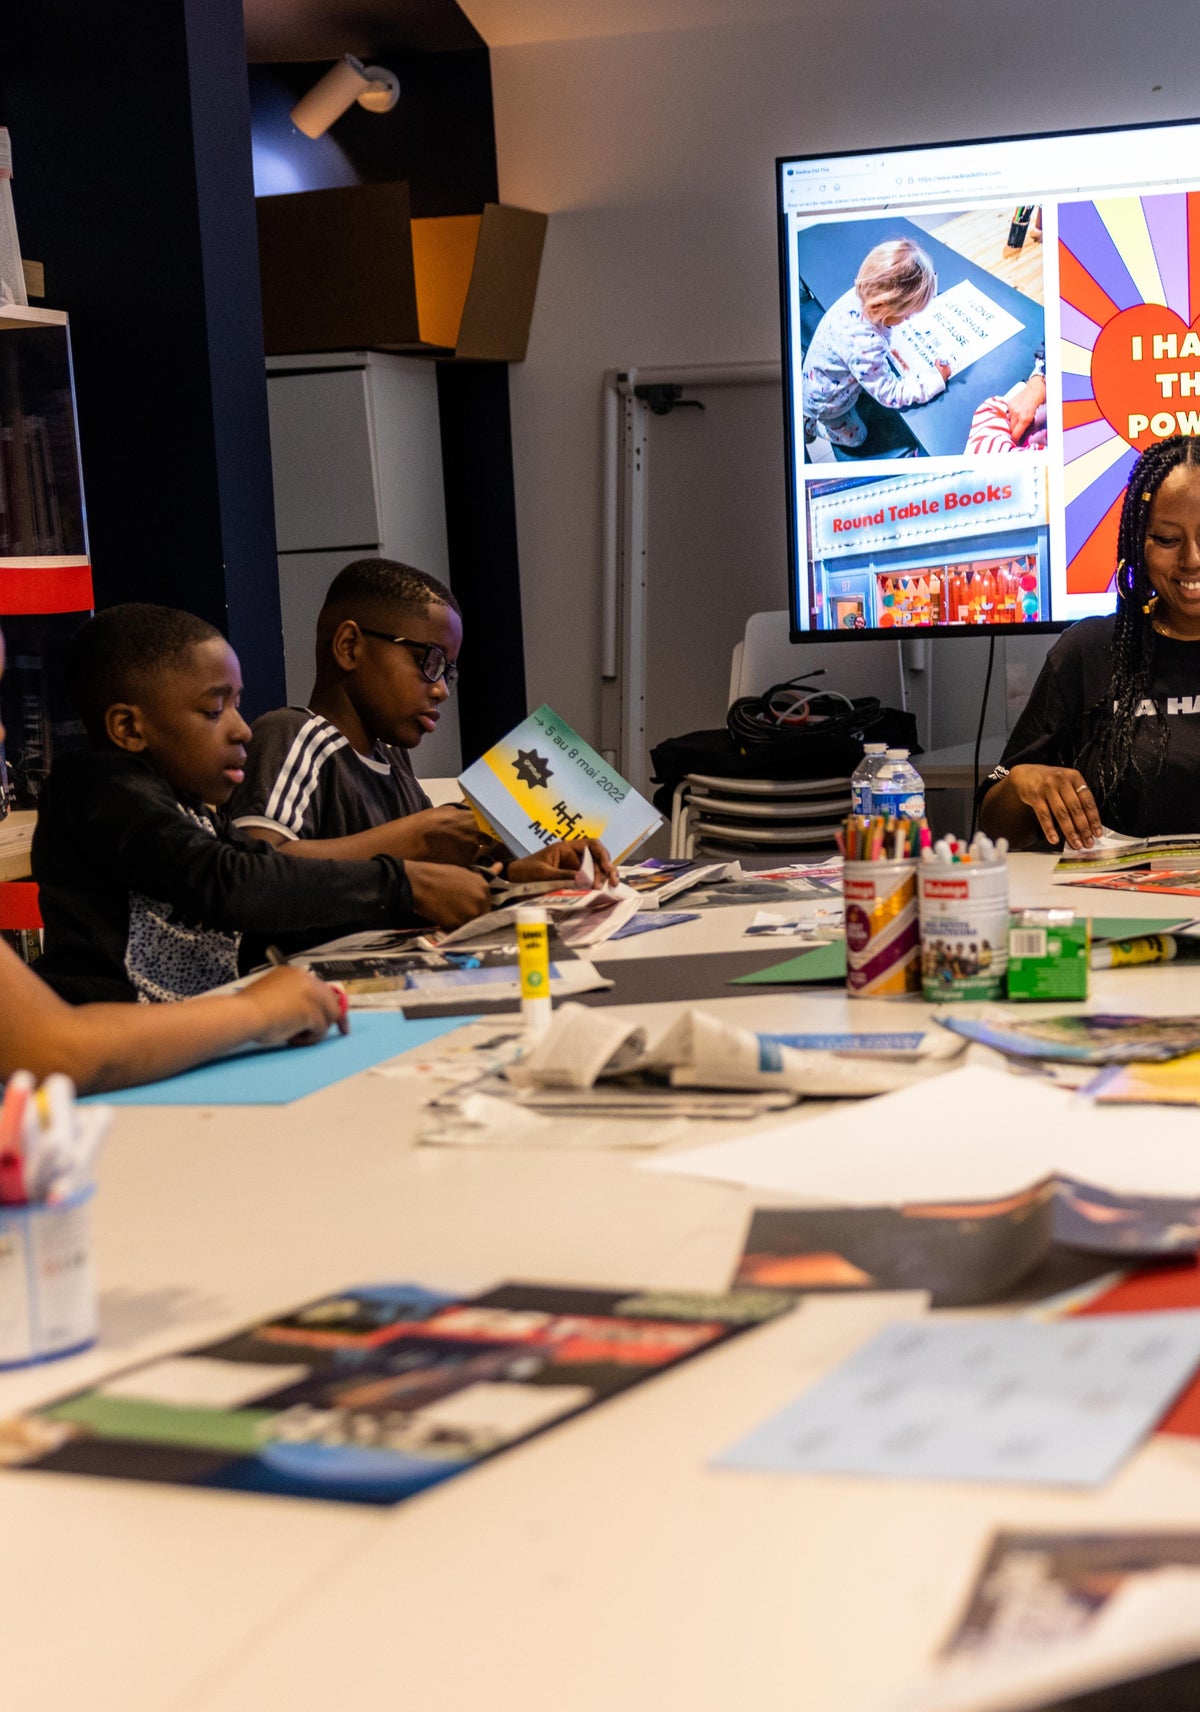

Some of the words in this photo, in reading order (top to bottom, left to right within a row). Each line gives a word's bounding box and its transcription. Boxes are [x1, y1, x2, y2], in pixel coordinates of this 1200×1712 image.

[1132, 335, 1143, 361] I
[832, 509, 885, 534] Round
[888, 500, 940, 522] Table
[944, 484, 1013, 511] Books
[545, 725, 557, 737] 5
[553, 735, 570, 752] au
[568, 748, 580, 760] 8
[576, 757, 601, 780] mai
[596, 775, 626, 804] 2022
